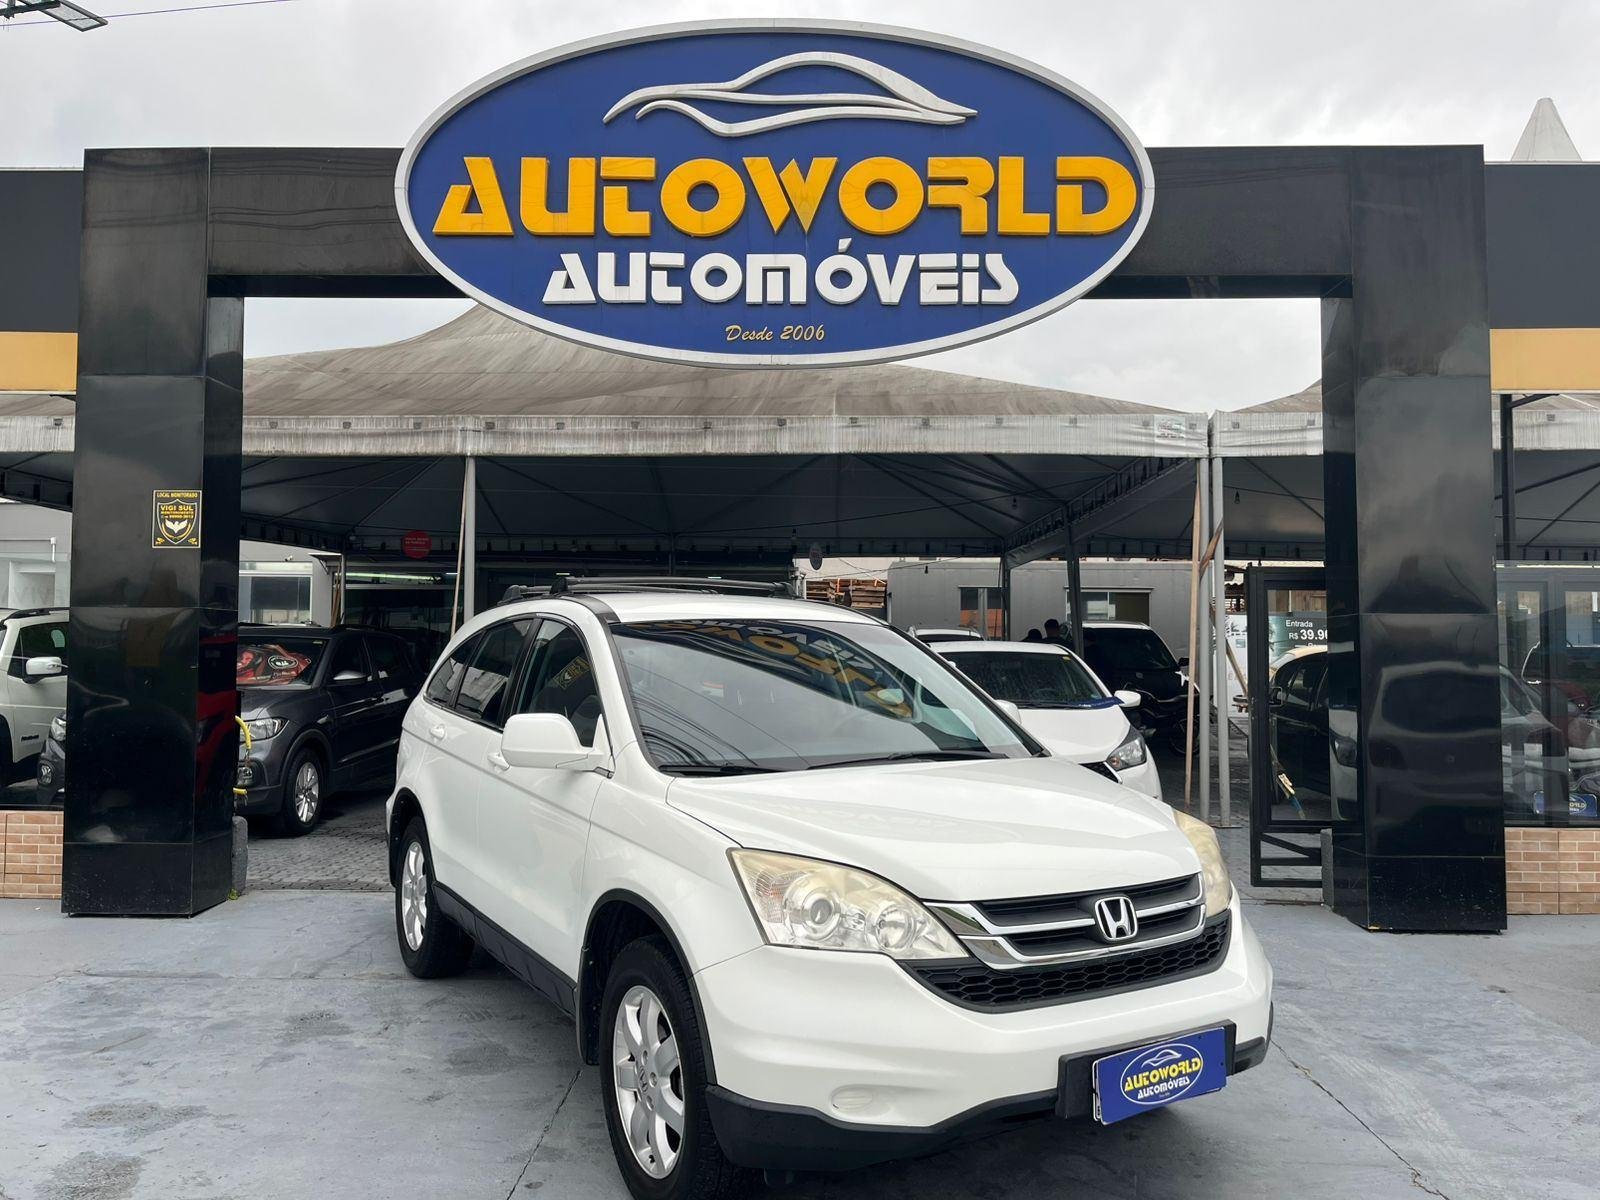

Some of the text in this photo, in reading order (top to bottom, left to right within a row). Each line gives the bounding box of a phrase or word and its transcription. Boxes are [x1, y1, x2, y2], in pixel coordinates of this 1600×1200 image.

[432, 155, 1138, 237] AUTOWORLD
[725, 323, 825, 341] Desde 2006
[1285, 619, 1313, 628] Entrada
[1288, 632, 1299, 640] R$
[1125, 1057, 1201, 1092] AUTOWORLD
